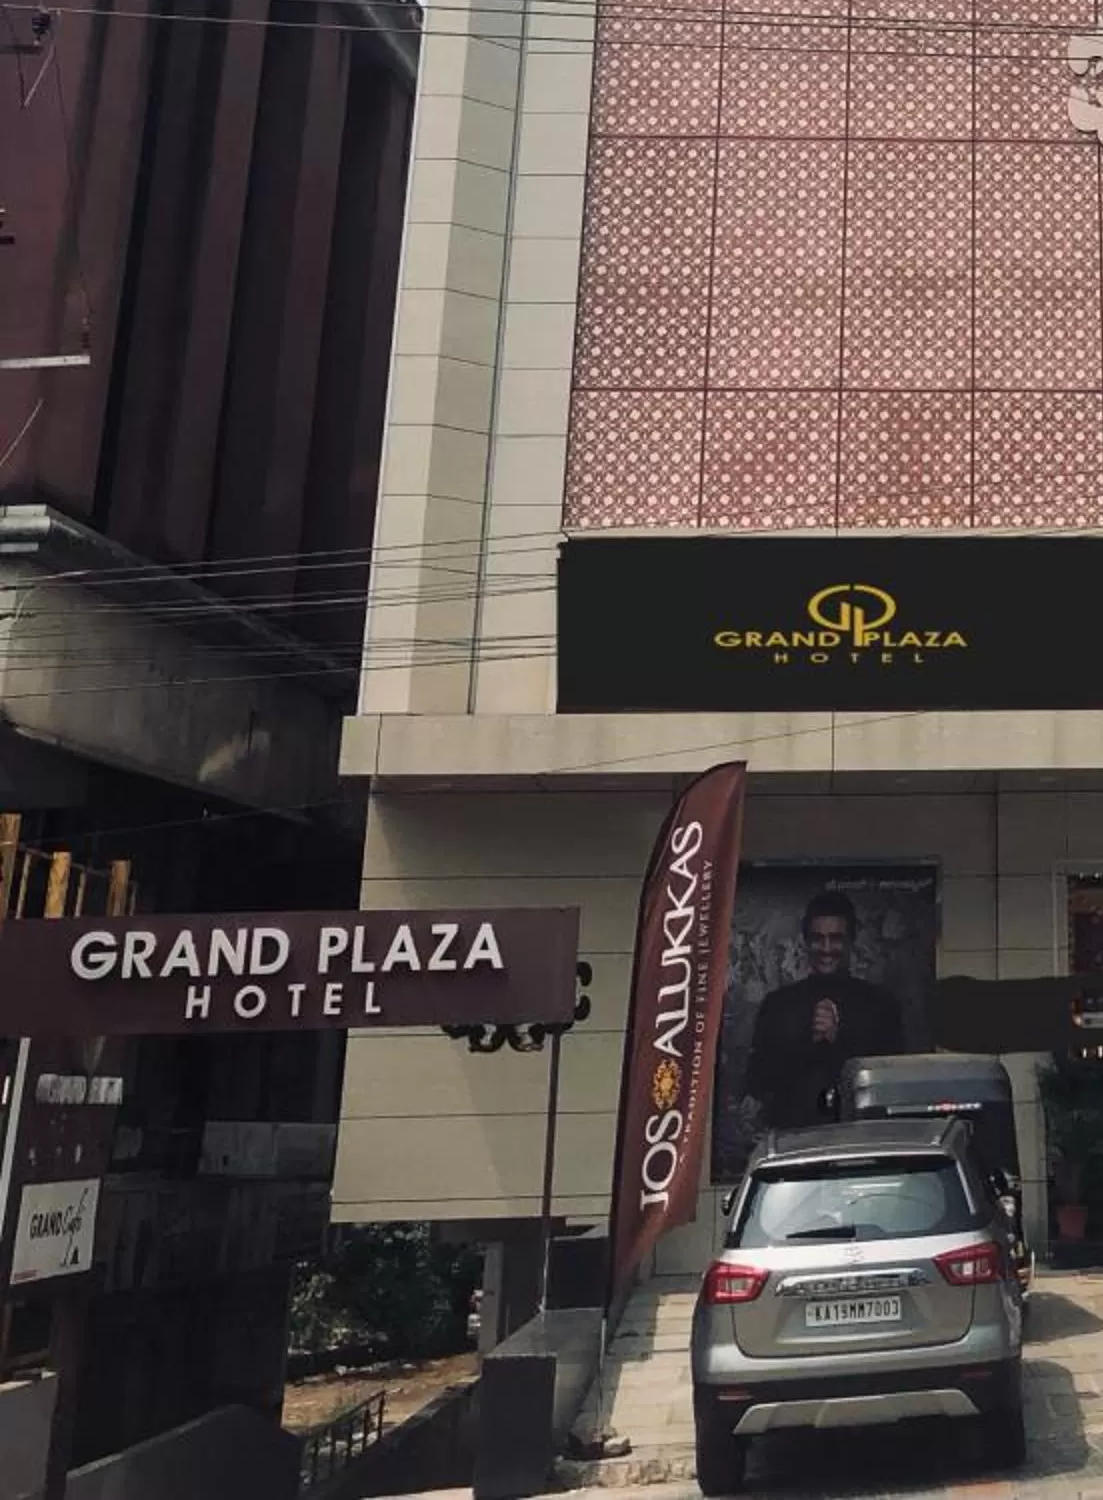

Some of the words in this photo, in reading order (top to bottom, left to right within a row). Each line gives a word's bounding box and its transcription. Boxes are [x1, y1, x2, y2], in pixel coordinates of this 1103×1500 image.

[714, 631, 841, 648] GRAND
[863, 631, 968, 648] PLAZA
[773, 652, 925, 664] HOTEL
[70, 927, 291, 980] GRAND
[317, 923, 504, 974] PLAZA
[652, 820, 703, 1058] ALUKKAS
[185, 981, 382, 1019] HOTEL
